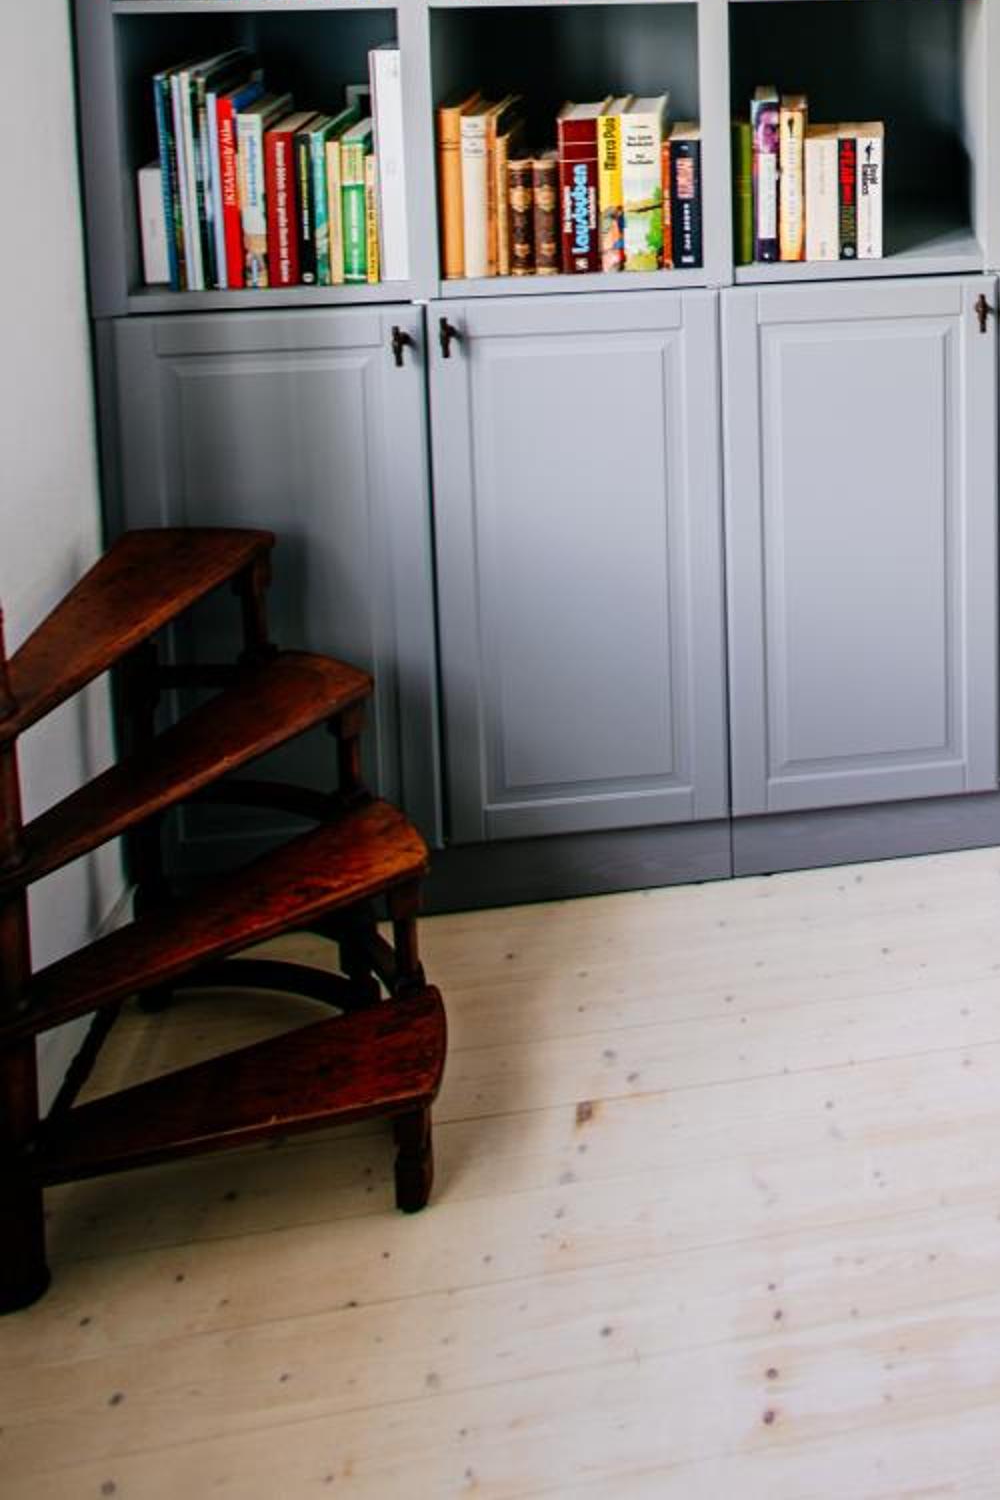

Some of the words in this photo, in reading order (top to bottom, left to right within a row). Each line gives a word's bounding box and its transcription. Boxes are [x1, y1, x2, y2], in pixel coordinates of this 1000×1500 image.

[602, 117, 616, 138] Polo
[603, 139, 618, 171] Marco
[571, 164, 591, 256] Lausbuben
